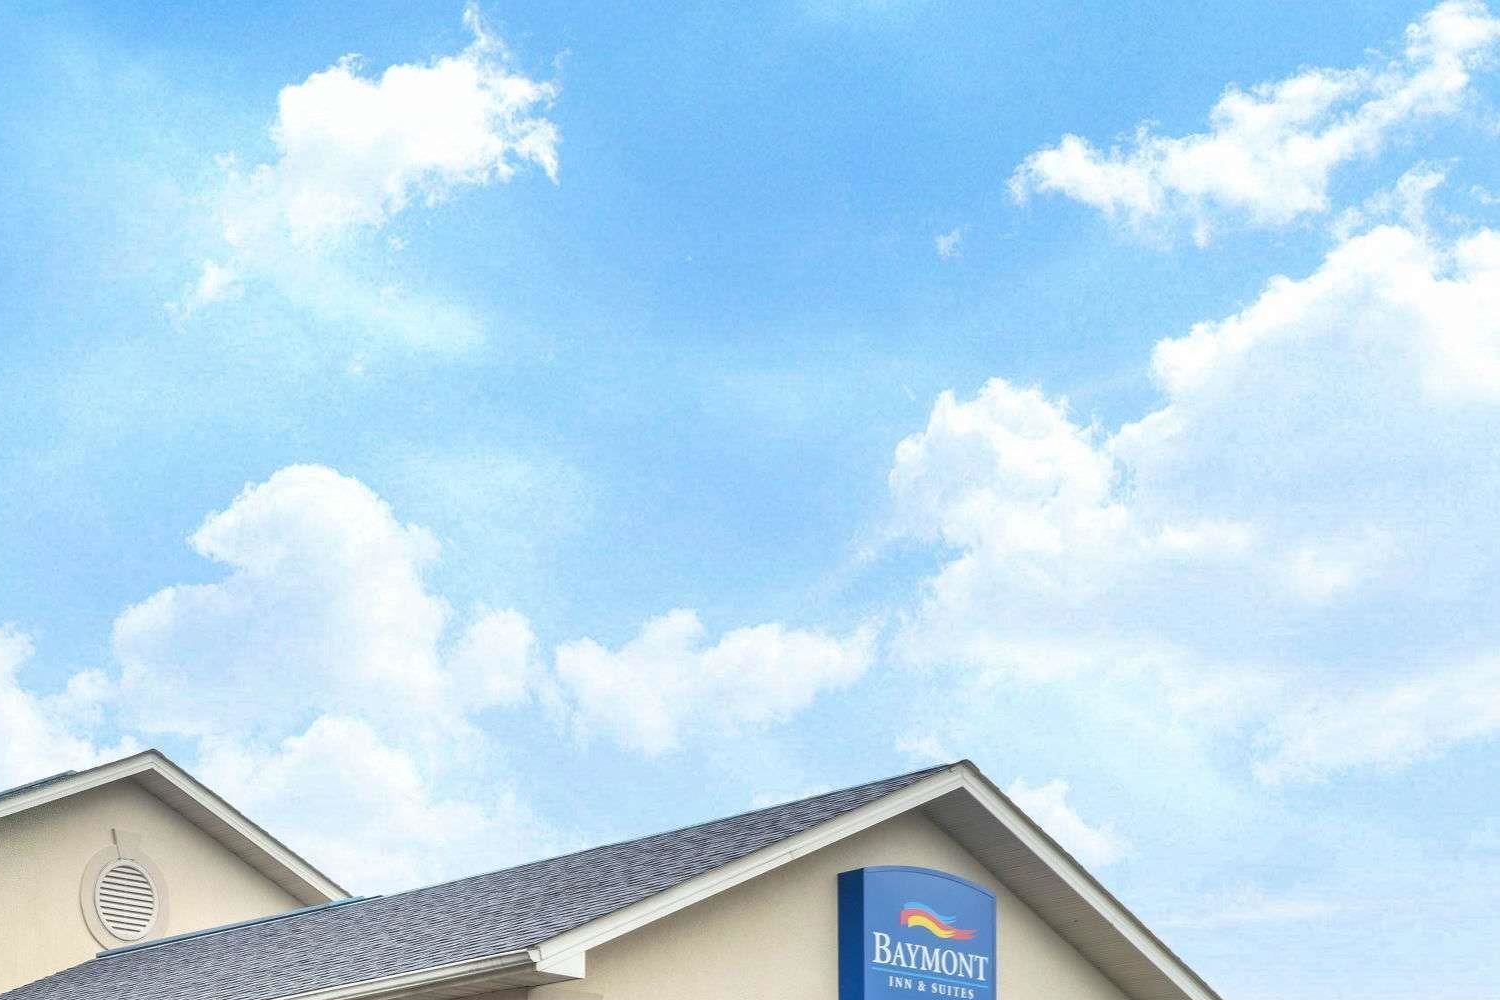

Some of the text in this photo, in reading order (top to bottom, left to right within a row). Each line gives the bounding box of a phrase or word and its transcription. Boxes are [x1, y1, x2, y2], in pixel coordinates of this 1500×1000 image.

[872, 931, 988, 981] BAYMONT
[888, 976, 975, 1000] INN & SUITES
